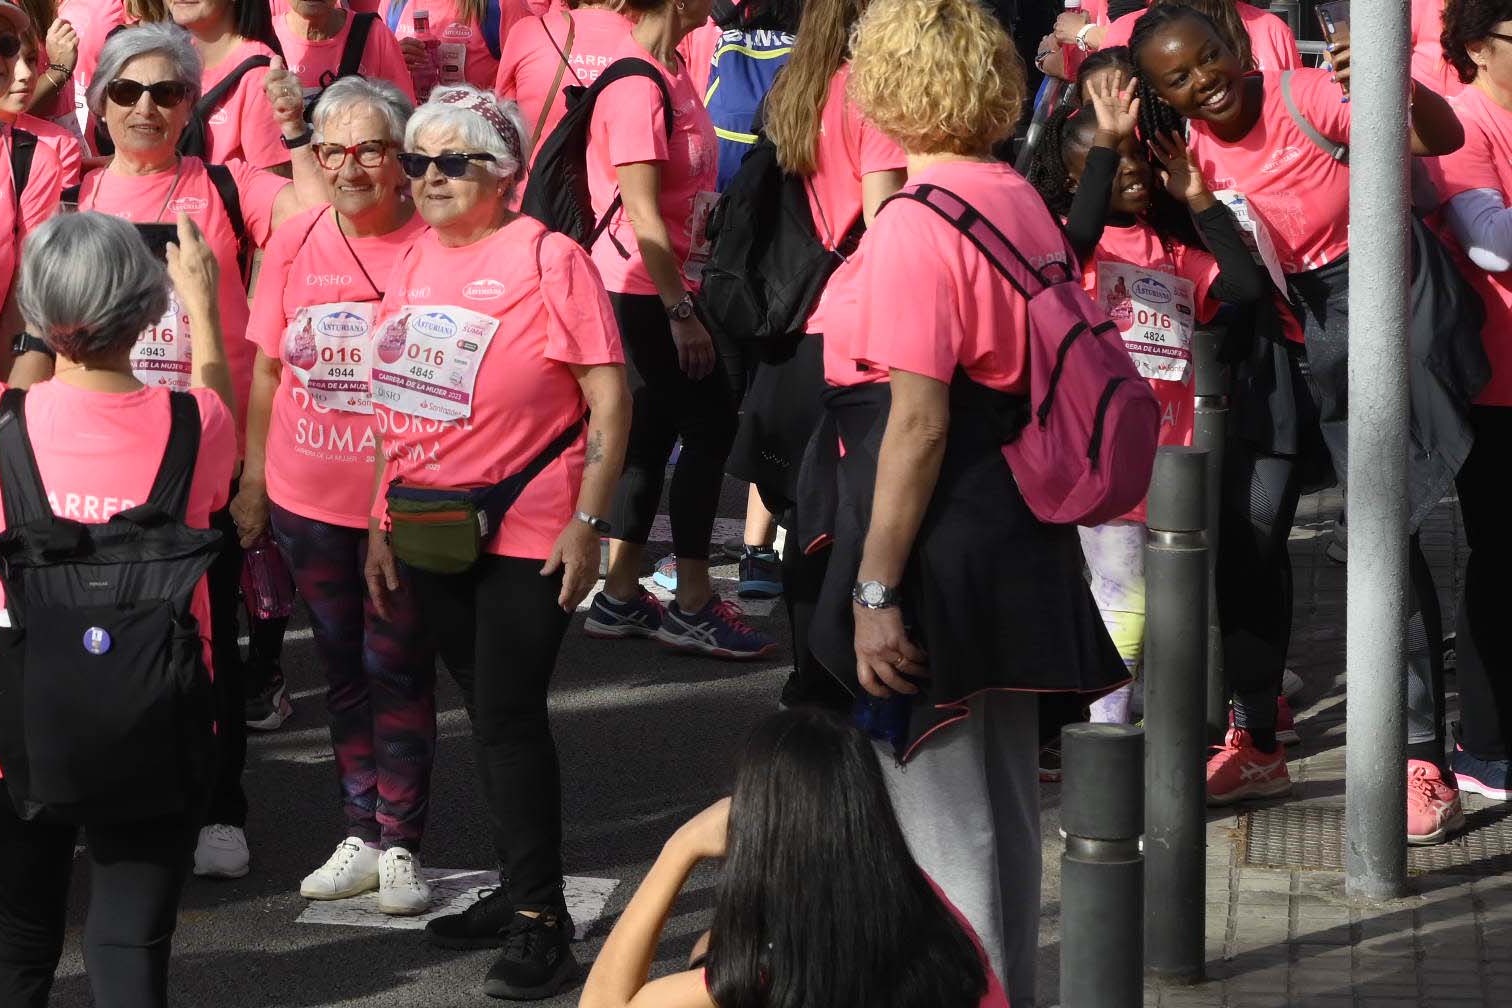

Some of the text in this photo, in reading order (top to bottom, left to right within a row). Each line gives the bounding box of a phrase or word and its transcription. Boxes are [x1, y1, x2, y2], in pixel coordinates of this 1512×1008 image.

[567, 54, 614, 67] CARR
[306, 274, 352, 287] OYSHO
[1138, 310, 1172, 329] 016
[320, 321, 366, 334] ASTURIANA
[415, 319, 454, 337] ASTURIANA
[1143, 331, 1166, 342] 4824
[140, 347, 166, 358] 4943
[321, 346, 362, 363] 016
[407, 343, 445, 366] 016
[327, 367, 355, 378] 4944
[409, 366, 434, 380] 4845
[327, 381, 348, 390] DE LA
[378, 373, 404, 386] CARRERA
[405, 379, 416, 389] DE
[416, 382, 426, 391] LA
[426, 385, 448, 397] MUJER
[295, 418, 376, 453] SUMA
[47, 492, 136, 521] ARRE
